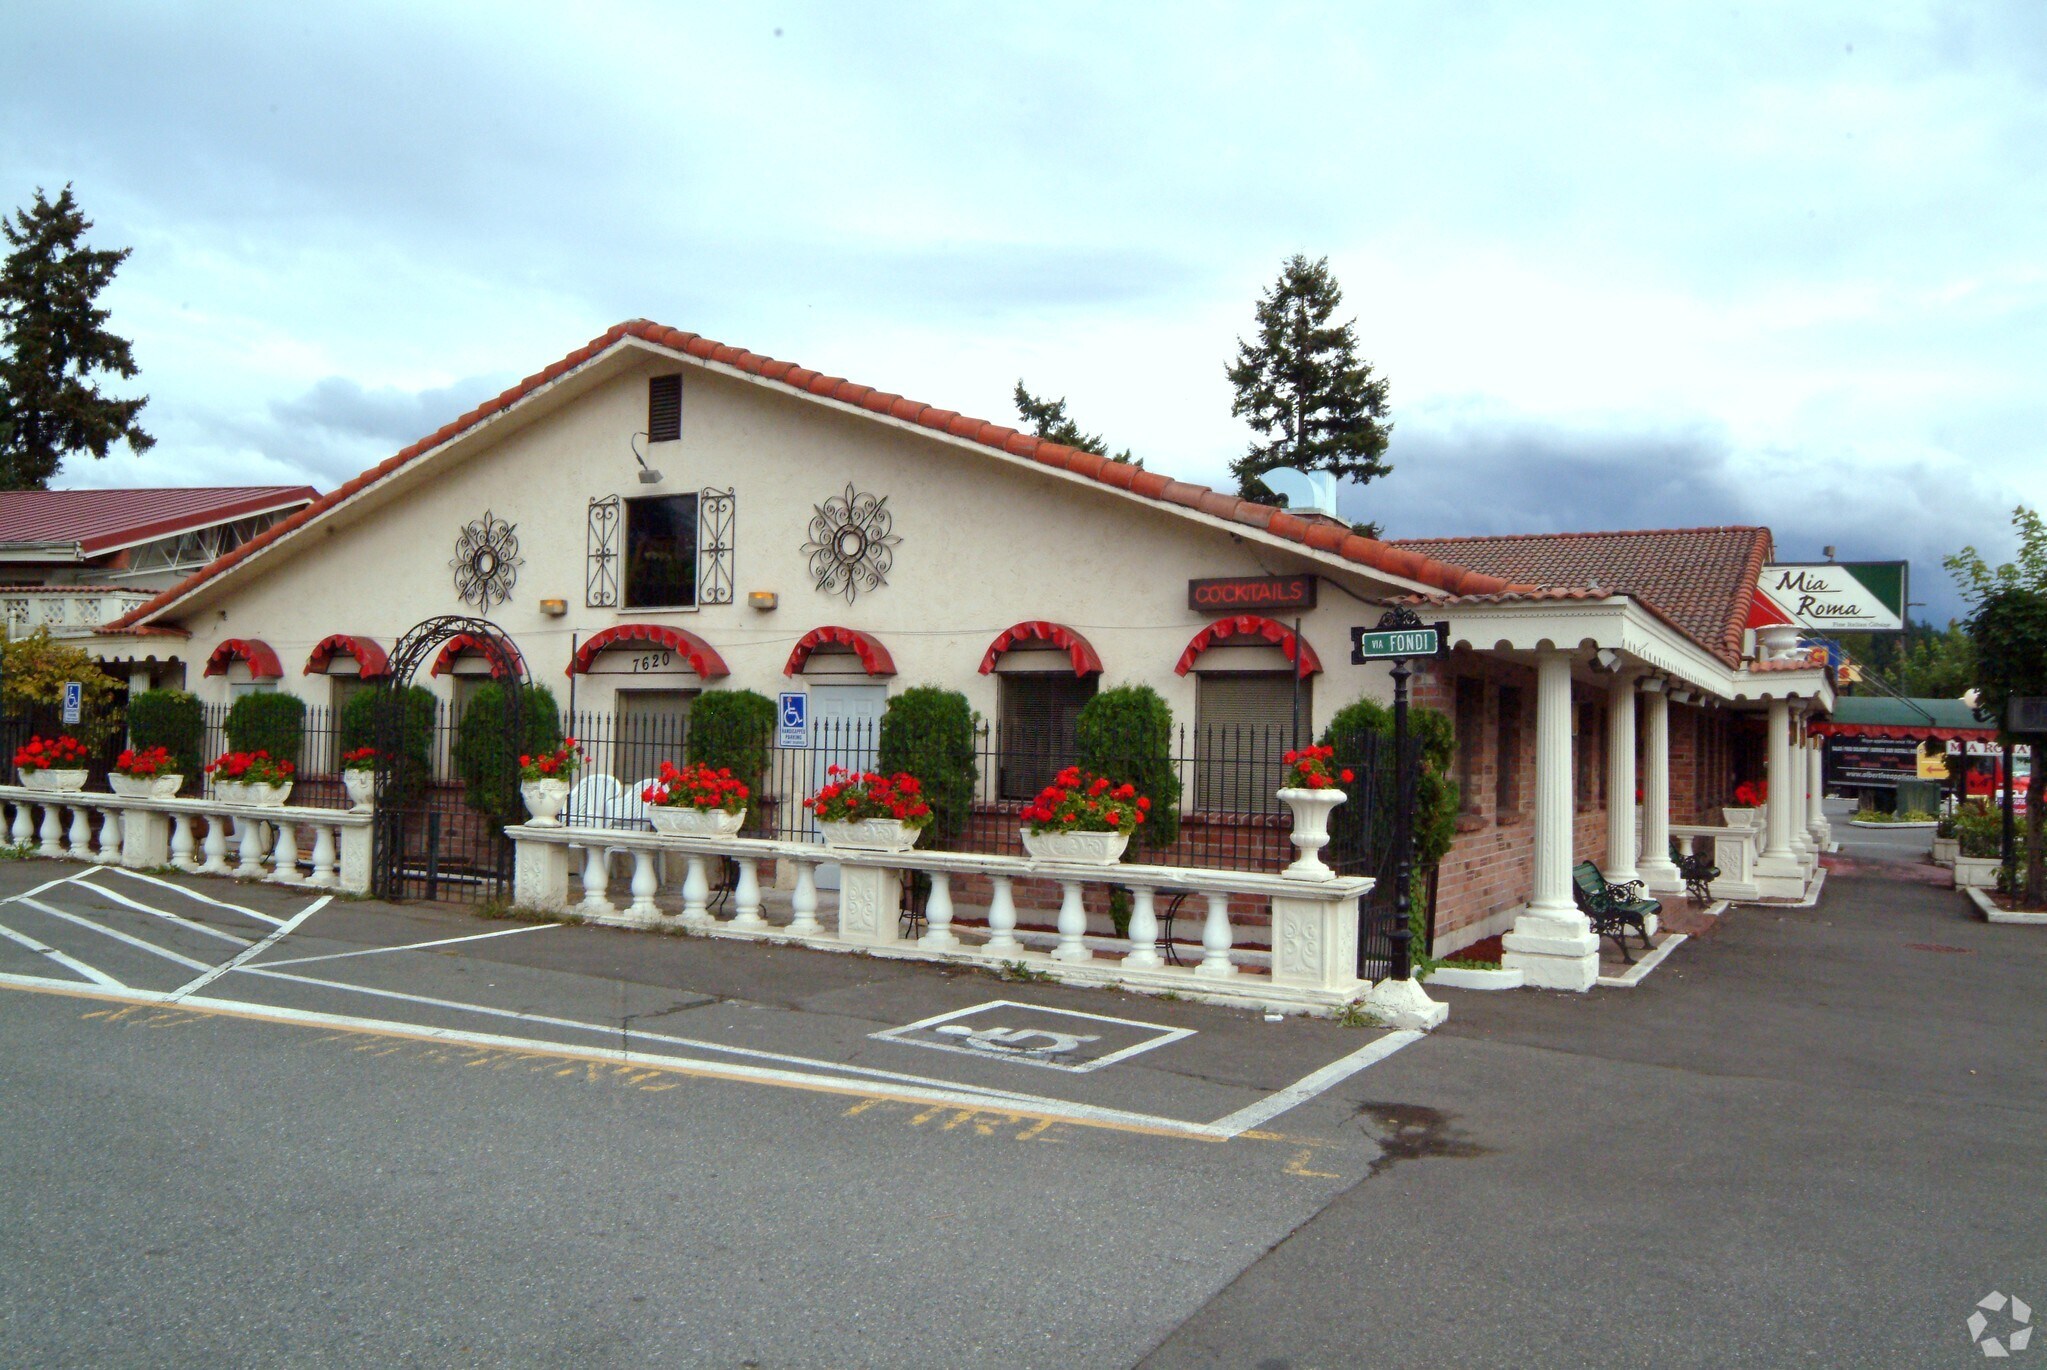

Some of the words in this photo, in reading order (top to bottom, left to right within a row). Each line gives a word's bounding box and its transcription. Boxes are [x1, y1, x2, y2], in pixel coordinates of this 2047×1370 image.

[1195, 581, 1304, 604] COCKTAILS
[1776, 570, 1842, 593] Mia
[1796, 594, 1876, 619] Roma
[1371, 639, 1384, 650] VIA
[1389, 633, 1429, 652] FONDI
[632, 652, 671, 673] 7620
[1949, 742, 1978, 753] MA
[1984, 743, 2029, 754] ROA
